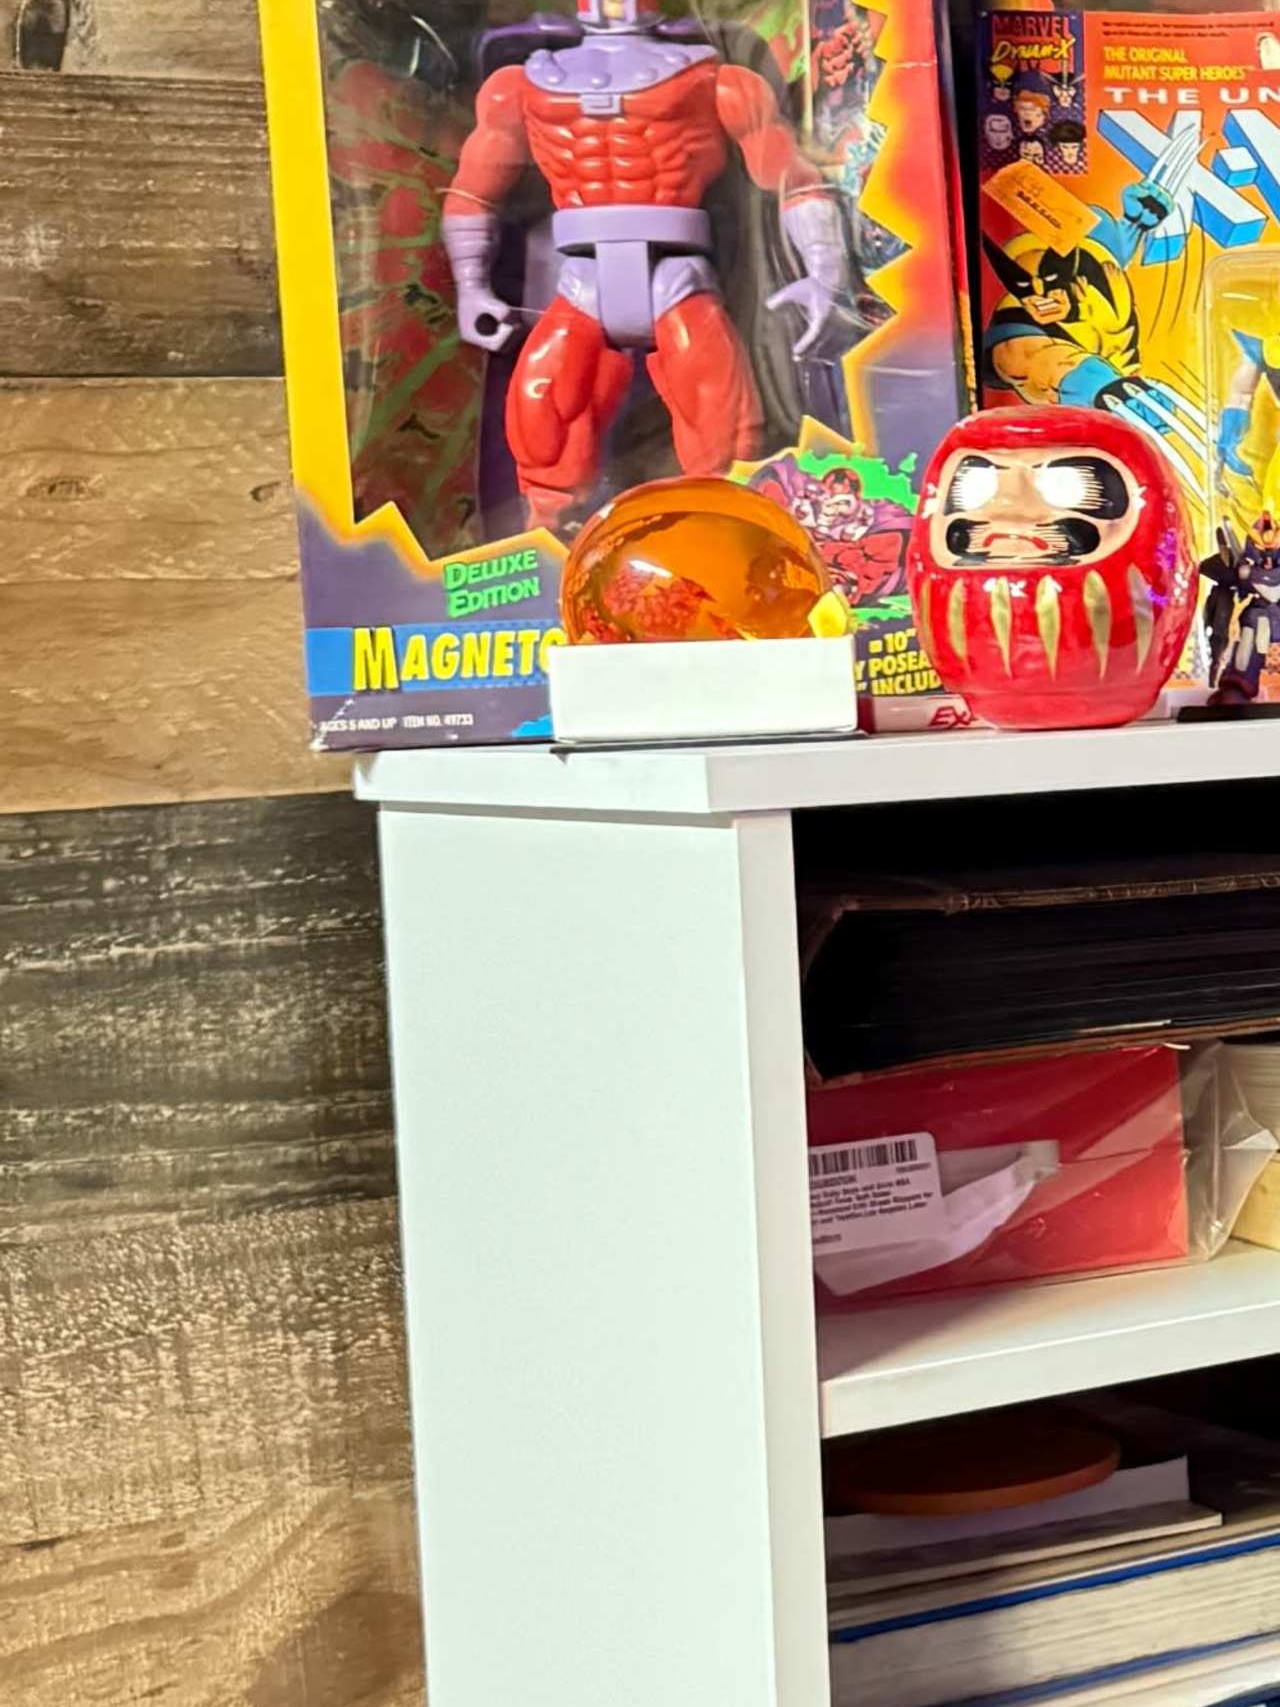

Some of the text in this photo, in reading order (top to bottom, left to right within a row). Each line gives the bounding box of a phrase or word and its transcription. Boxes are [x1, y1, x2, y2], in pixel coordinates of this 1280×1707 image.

[992, 14, 1073, 40] MARVEL
[1103, 46, 1188, 63] THE ORIGINAL
[1103, 65, 1246, 81] MUTANT SUPER HEROES
[1104, 87, 1199, 104] THE
[445, 548, 539, 590] DELUXE
[447, 576, 542, 619] EDITION
[871, 669, 942, 695] INCLUD
[358, 718, 380, 730] AND
[381, 716, 397, 729] UP
